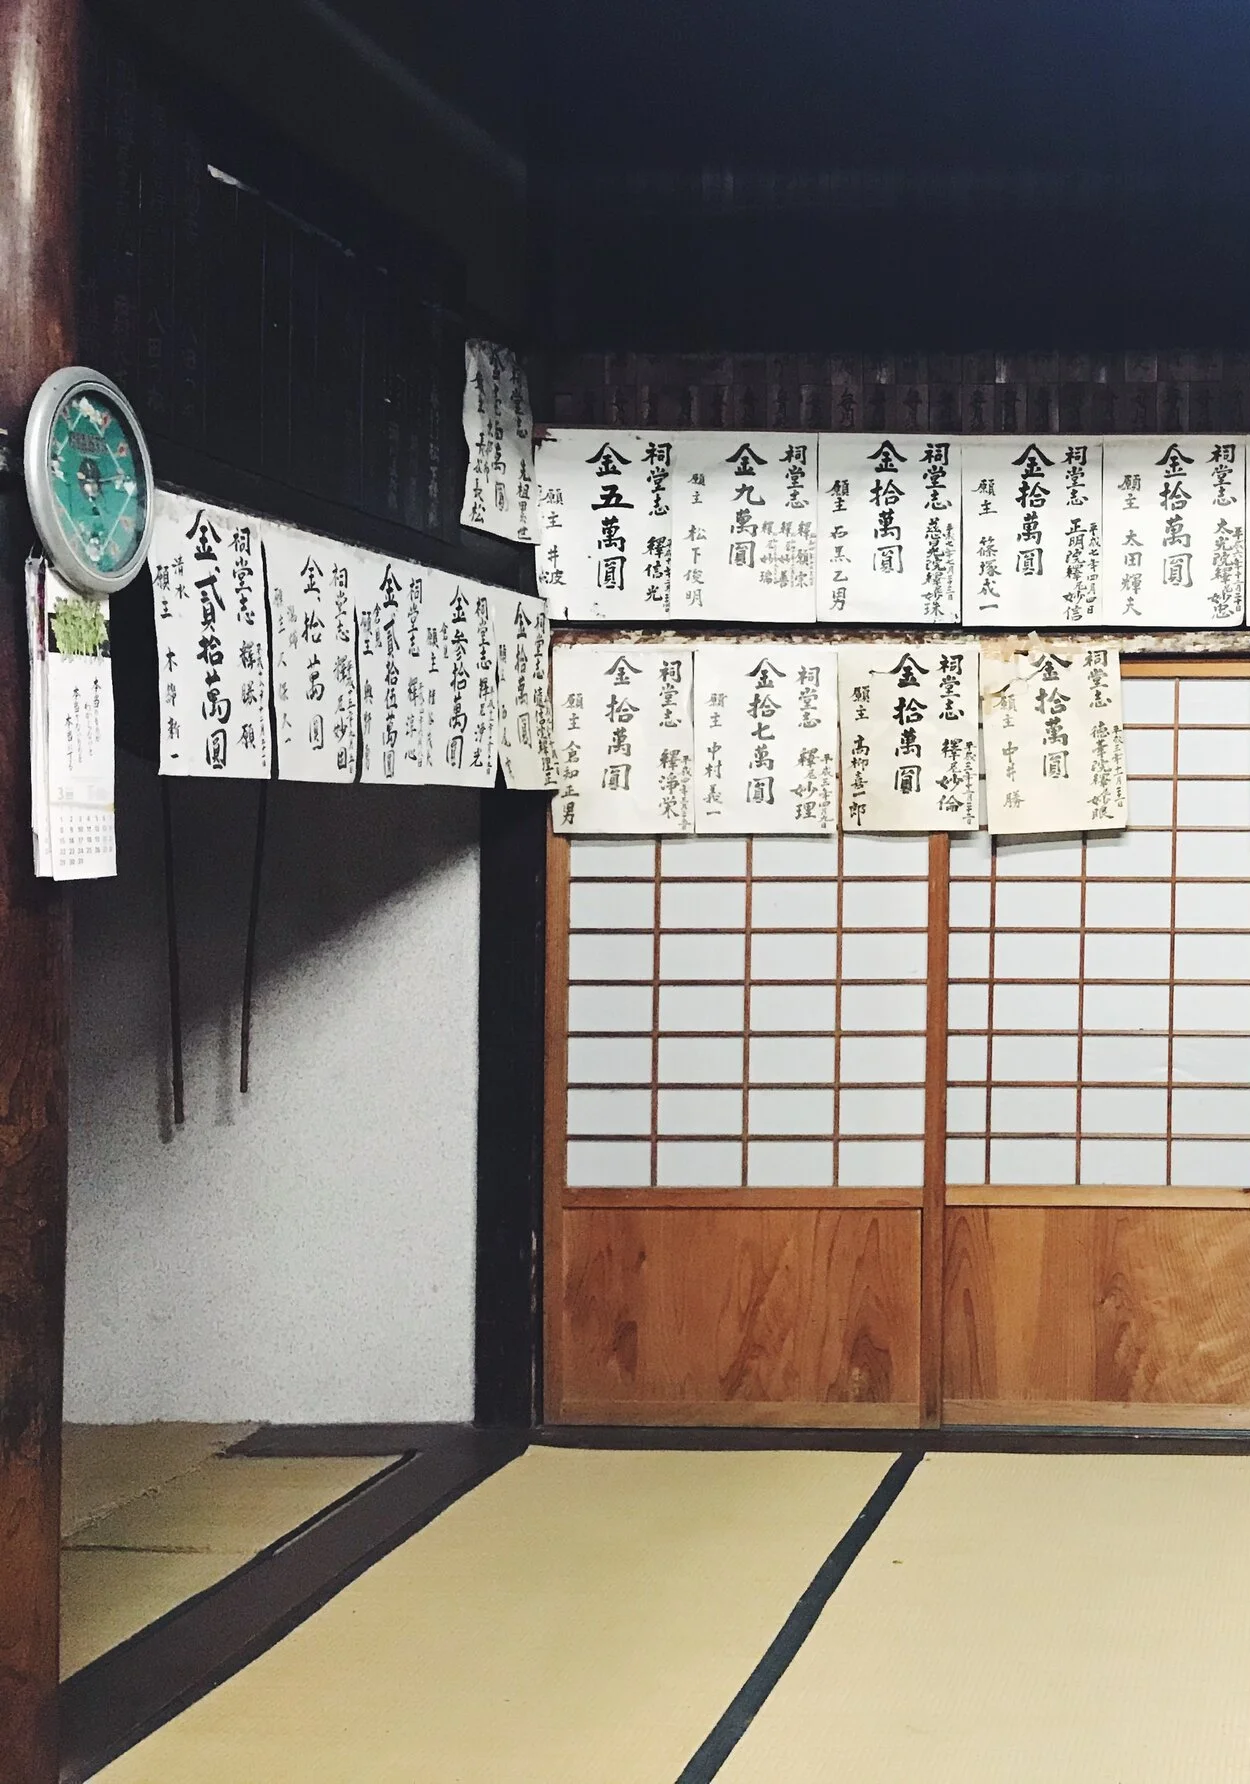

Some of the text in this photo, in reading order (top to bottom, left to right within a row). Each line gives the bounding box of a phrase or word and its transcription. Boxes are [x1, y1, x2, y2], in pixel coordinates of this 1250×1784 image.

[539, 488, 563, 529] 願主
[641, 442, 672, 516] 祠堂志
[725, 443, 769, 568] 金九萬圓
[779, 444, 809, 509] 祠堂志
[825, 479, 849, 512] 願主
[867, 440, 908, 573] 金拾萬圓
[919, 443, 952, 510] 祠堂志
[971, 479, 997, 516] 願主
[1060, 446, 1088, 505] 祠堂志
[1118, 474, 1141, 510] 願主
[1206, 444, 1237, 506] 祠堂志
[585, 442, 634, 591] 金五萬圓
[683, 473, 707, 607] 願主 松下俊明
[1011, 443, 1055, 576] 金拾萬圓
[1155, 443, 1194, 587] 金拾萬圓
[228, 527, 255, 625] 祠堂志
[329, 563, 350, 643] 祠堂志
[408, 578, 422, 657] 祠堂志
[475, 597, 492, 670] 祠堂志
[561, 693, 583, 730] 願主
[659, 660, 682, 727] 祠堂志
[707, 693, 728, 728] 願主
[796, 665, 821, 728] 祠堂志
[851, 685, 870, 721] 願主
[938, 654, 964, 720] 祠堂志
[992, 692, 1017, 728] 願主
[1083, 650, 1112, 708] 祠堂志
[602, 656, 643, 790] 金拾萬圓
[745, 658, 786, 805] 金拾七萬圓
[889, 653, 929, 794] 金拾萬圓
[1031, 652, 1073, 778] 金拾萬圓
